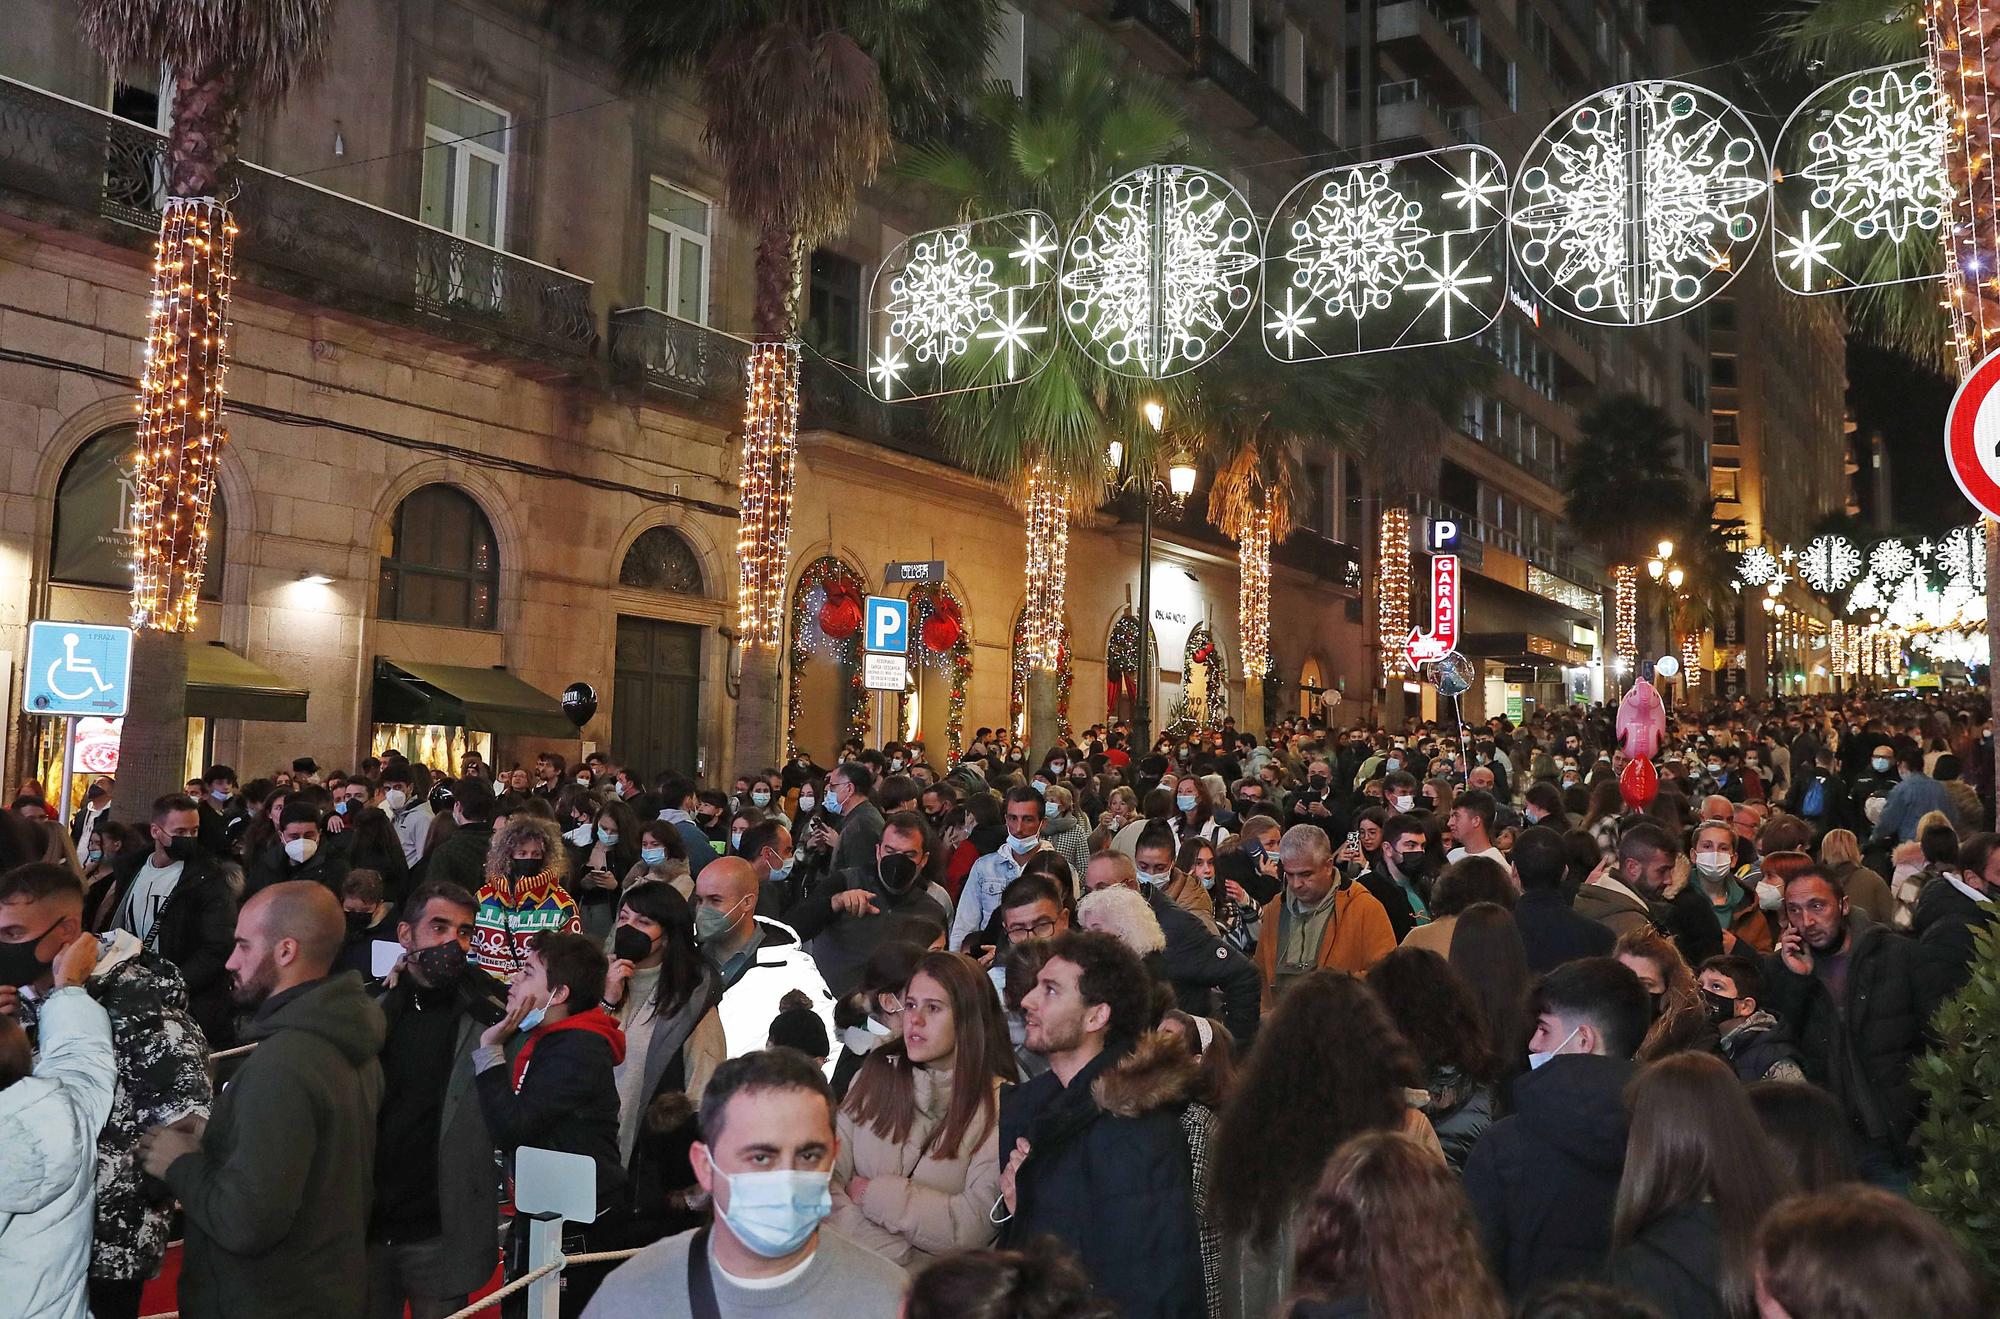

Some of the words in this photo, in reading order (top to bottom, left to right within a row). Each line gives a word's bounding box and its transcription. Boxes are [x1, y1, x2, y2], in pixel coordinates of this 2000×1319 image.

[1434, 521, 1457, 549] P
[1437, 559, 1453, 635] GARAJE
[875, 606, 901, 647] P
